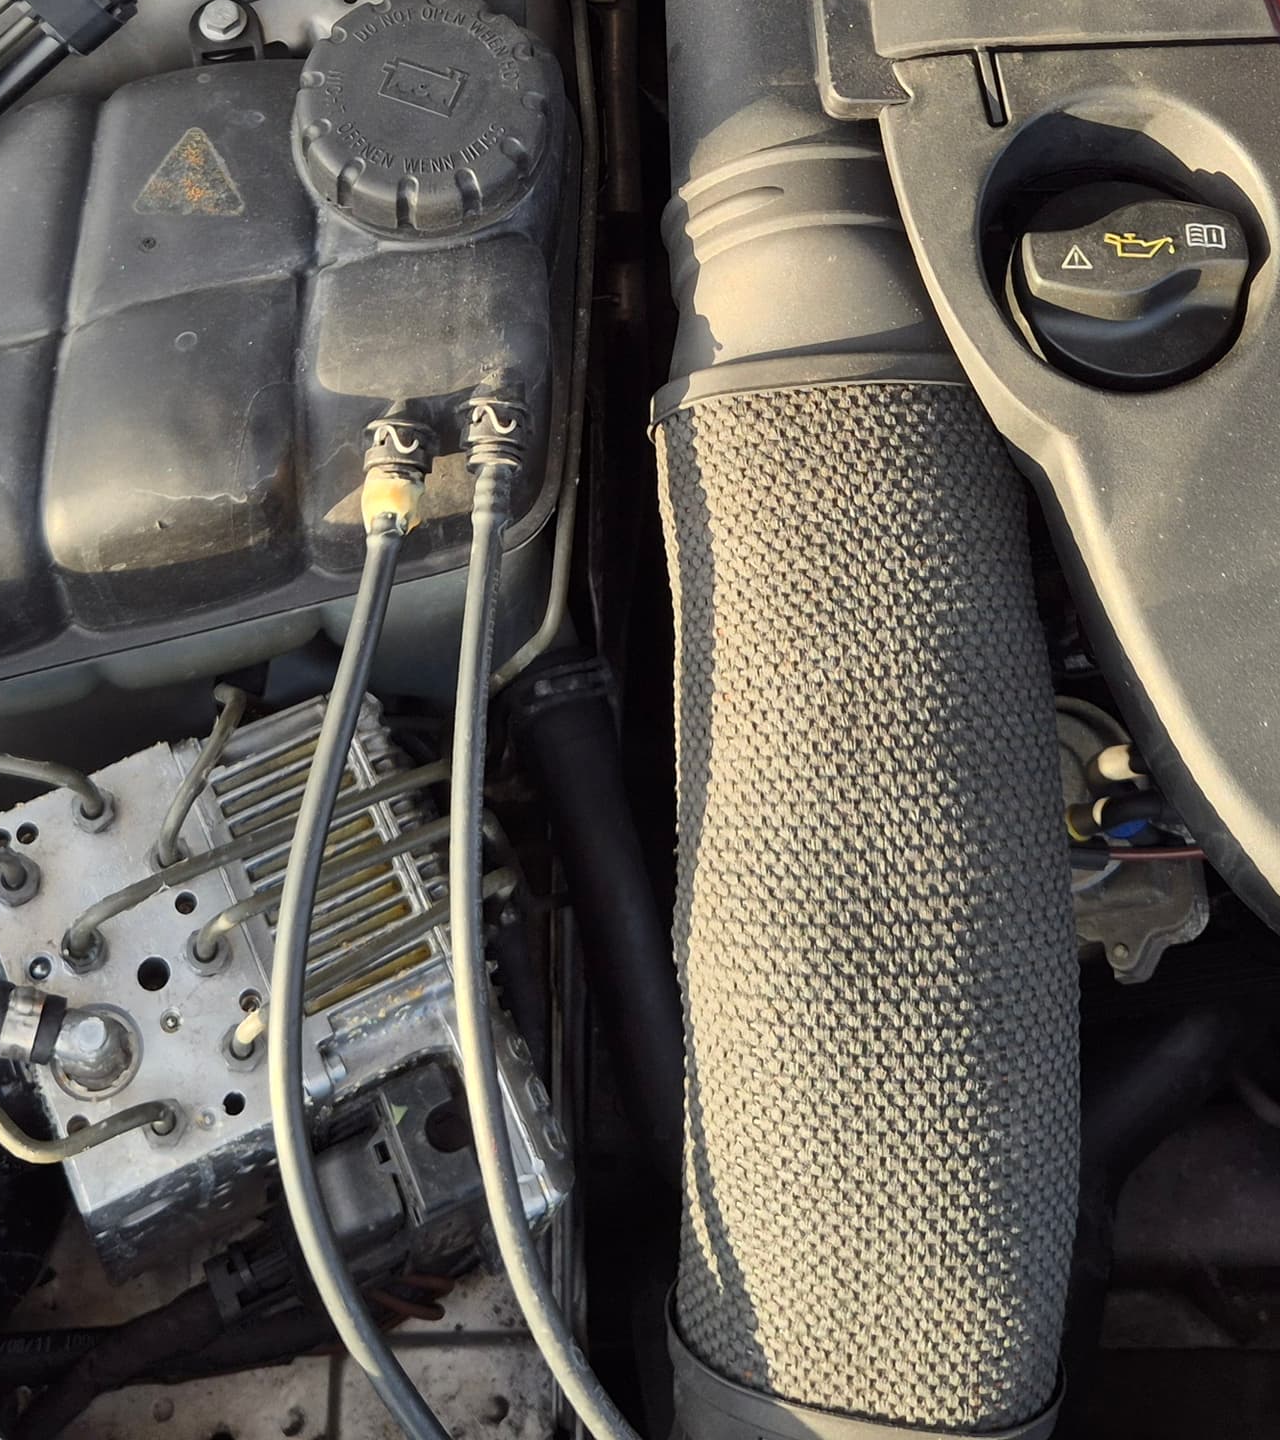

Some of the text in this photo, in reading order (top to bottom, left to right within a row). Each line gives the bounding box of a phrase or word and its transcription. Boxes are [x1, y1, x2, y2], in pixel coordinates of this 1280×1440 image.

[353, 23, 377, 42] DO
[380, 8, 413, 28] NOT
[420, 7, 466, 27] OPEN
[468, 19, 510, 59] WHEN
[402, 155, 455, 174] WENN
